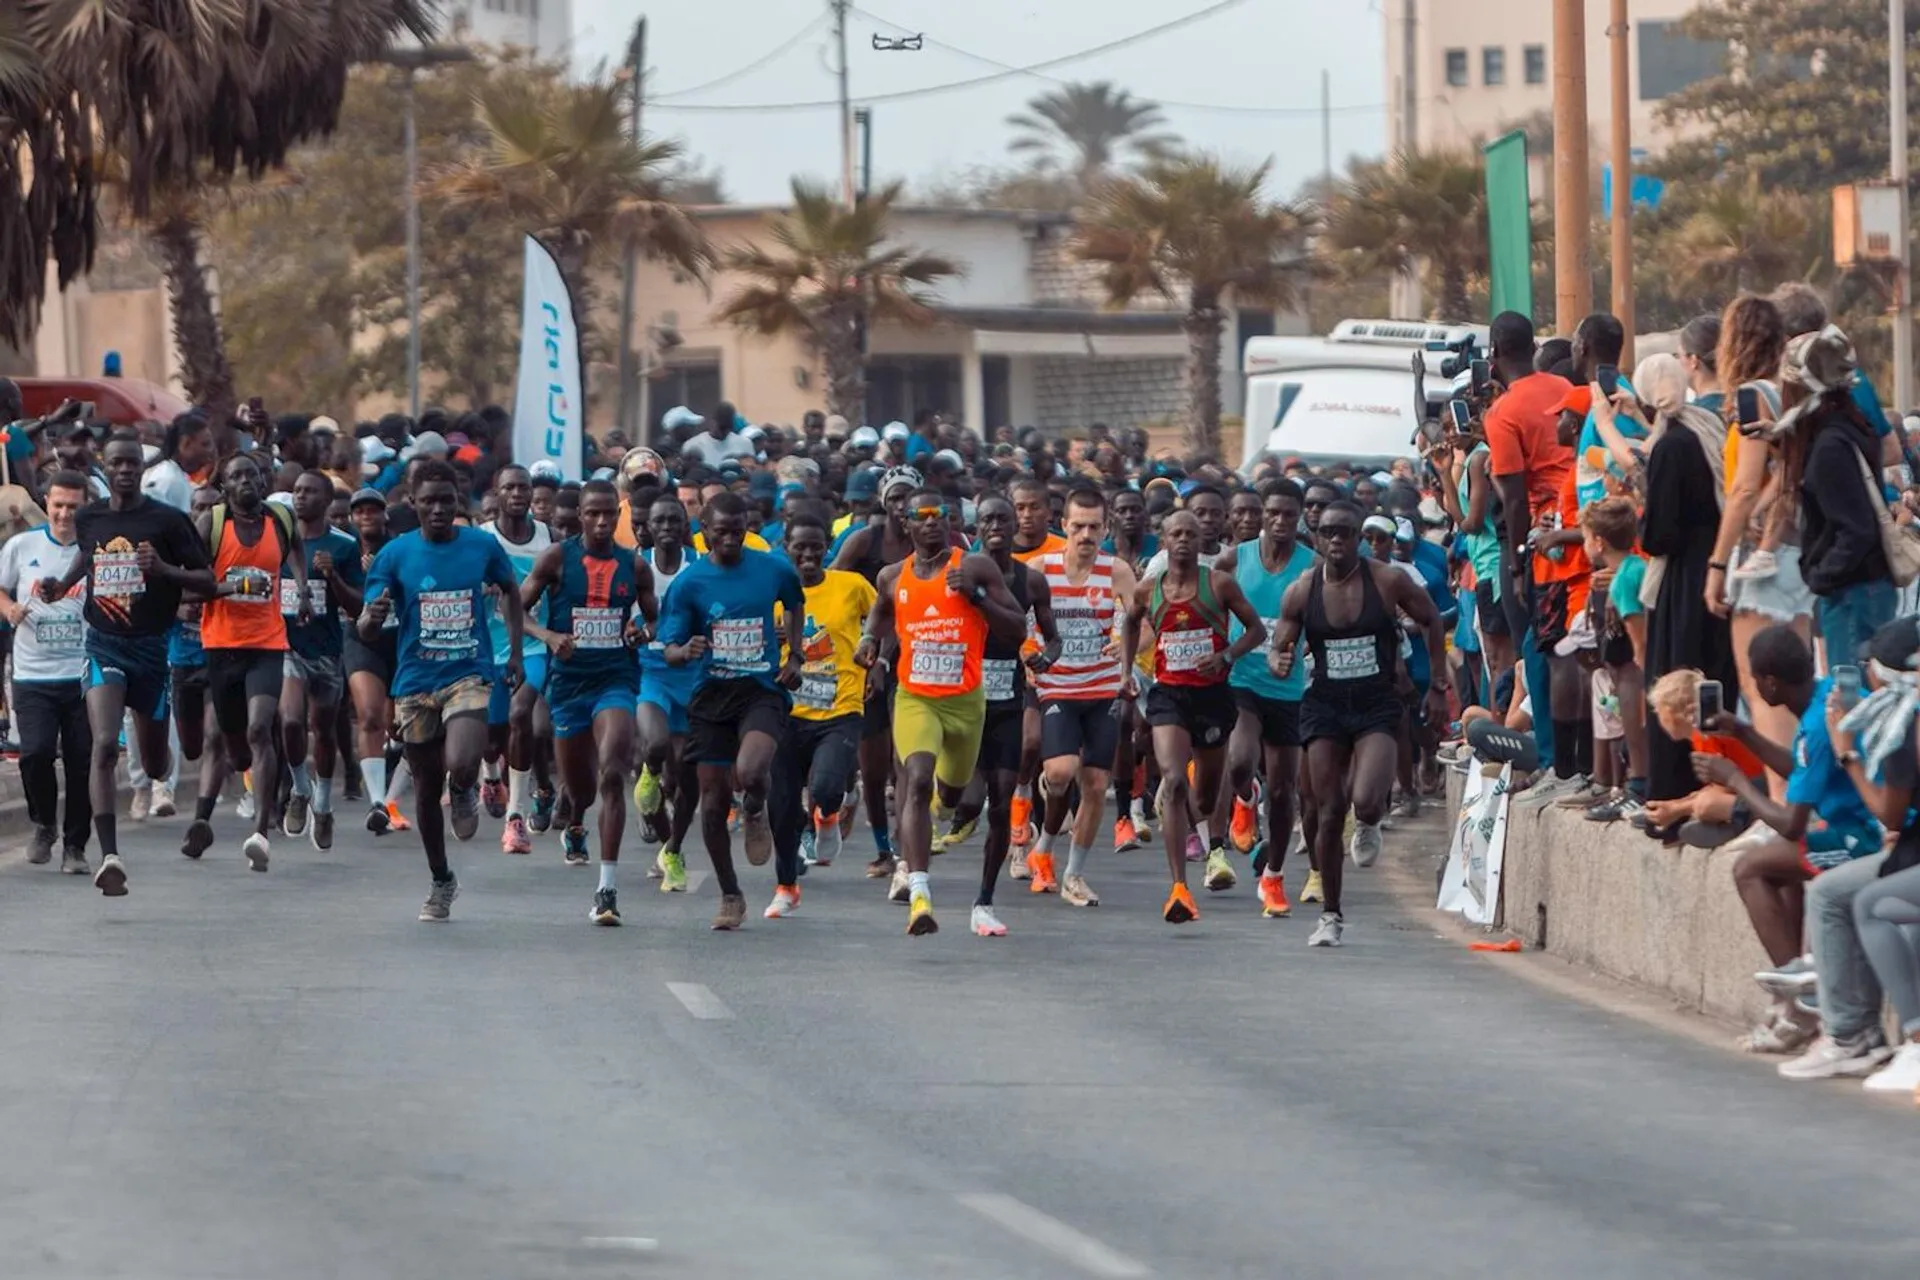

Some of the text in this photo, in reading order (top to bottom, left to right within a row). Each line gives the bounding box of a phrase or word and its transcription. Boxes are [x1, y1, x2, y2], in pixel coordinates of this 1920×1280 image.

[422, 603, 461, 618] 5005
[575, 621, 613, 636] 6010
[714, 632, 752, 646] 5174
[1166, 642, 1203, 658] 6069
[913, 654, 954, 672] 6019
